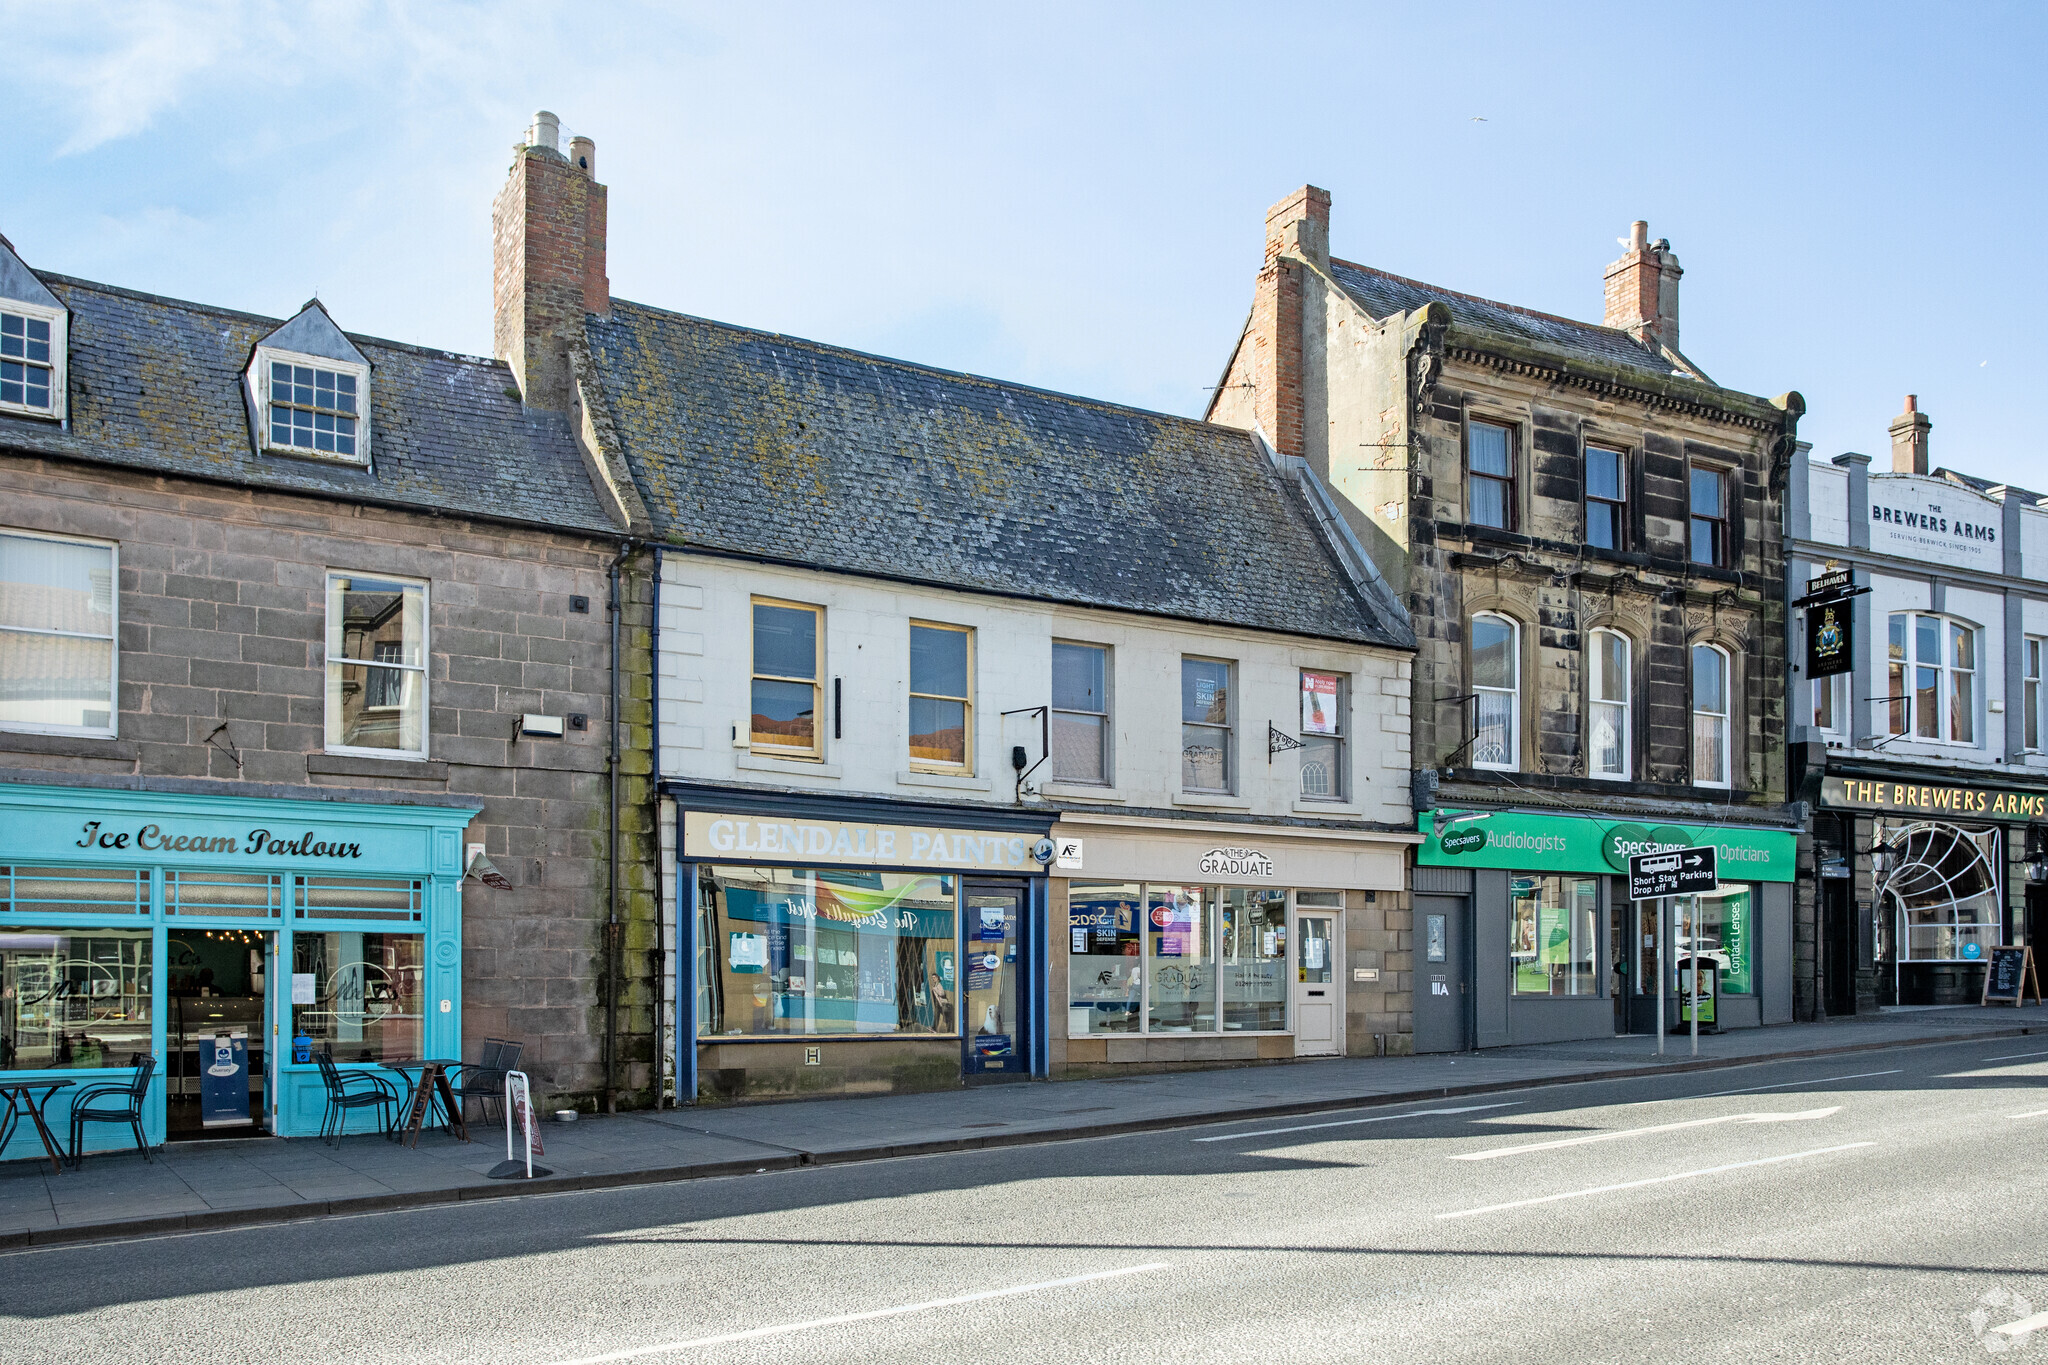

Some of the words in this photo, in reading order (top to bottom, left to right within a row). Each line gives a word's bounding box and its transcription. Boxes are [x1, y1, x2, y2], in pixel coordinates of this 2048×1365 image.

[1928, 504, 1941, 513] THE
[1872, 505, 1947, 533] BREWERS
[1953, 521, 1996, 542] ARMS
[1890, 532, 1917, 542] SERVING
[1919, 537, 1947, 548] BERWICK
[1949, 543, 1967, 551] SINCE
[1811, 573, 1847, 591] BELHAVEN
[1196, 681, 1215, 689] LIGHT
[1196, 692, 1215, 701] SKIN
[1844, 780, 1885, 803] THE
[1893, 785, 1987, 812] BREWERS
[1992, 794, 2045, 816] ARMS
[76, 821, 131, 849] Ice
[137, 824, 239, 854] Cream
[244, 829, 362, 859] Parlour
[708, 820, 897, 859] GLENDALE
[909, 832, 1025, 866] PAINTS
[1444, 834, 1480, 849] Specsavers
[1485, 830, 1567, 854] Audiologists
[1230, 849, 1243, 858] THE
[1720, 844, 1770, 864] Opticians
[1200, 859, 1273, 876] GRADUATE
[1633, 877, 1656, 886] Short
[1658, 874, 1677, 883] Stay
[1680, 870, 1713, 881] Parking
[1633, 886, 1652, 896] Drop
[1654, 884, 1666, 893] off
[1730, 902, 1740, 935] Lenses
[1096, 929, 1117, 937] SKIN
[1730, 937, 1740, 975] Contact
[1155, 972, 1208, 983] GRADUATE
